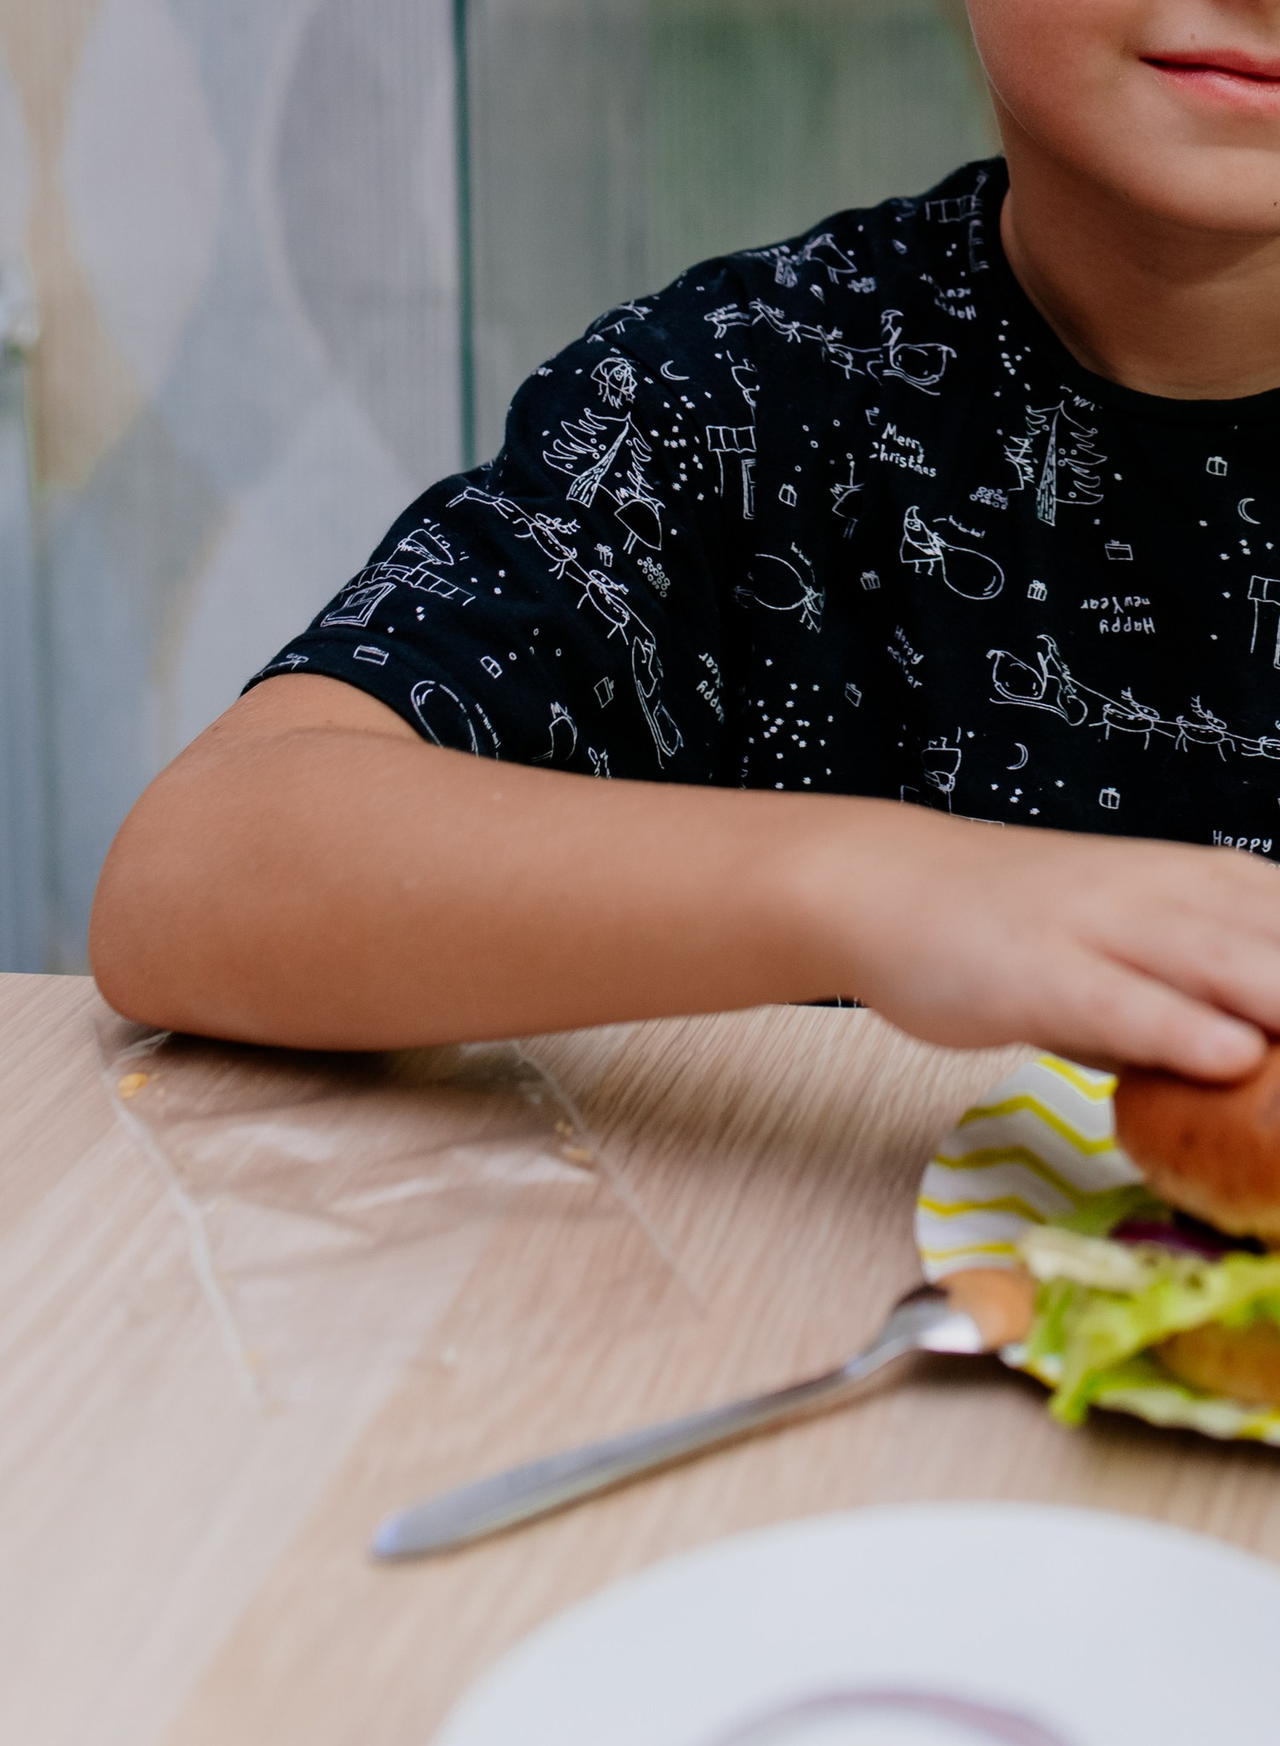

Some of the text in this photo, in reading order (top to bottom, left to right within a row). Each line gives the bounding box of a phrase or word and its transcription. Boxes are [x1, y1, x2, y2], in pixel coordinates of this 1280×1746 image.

[881, 422, 925, 464] Merry
[1099, 616, 1156, 635] Happy
[1212, 829, 1273, 853] Happy
